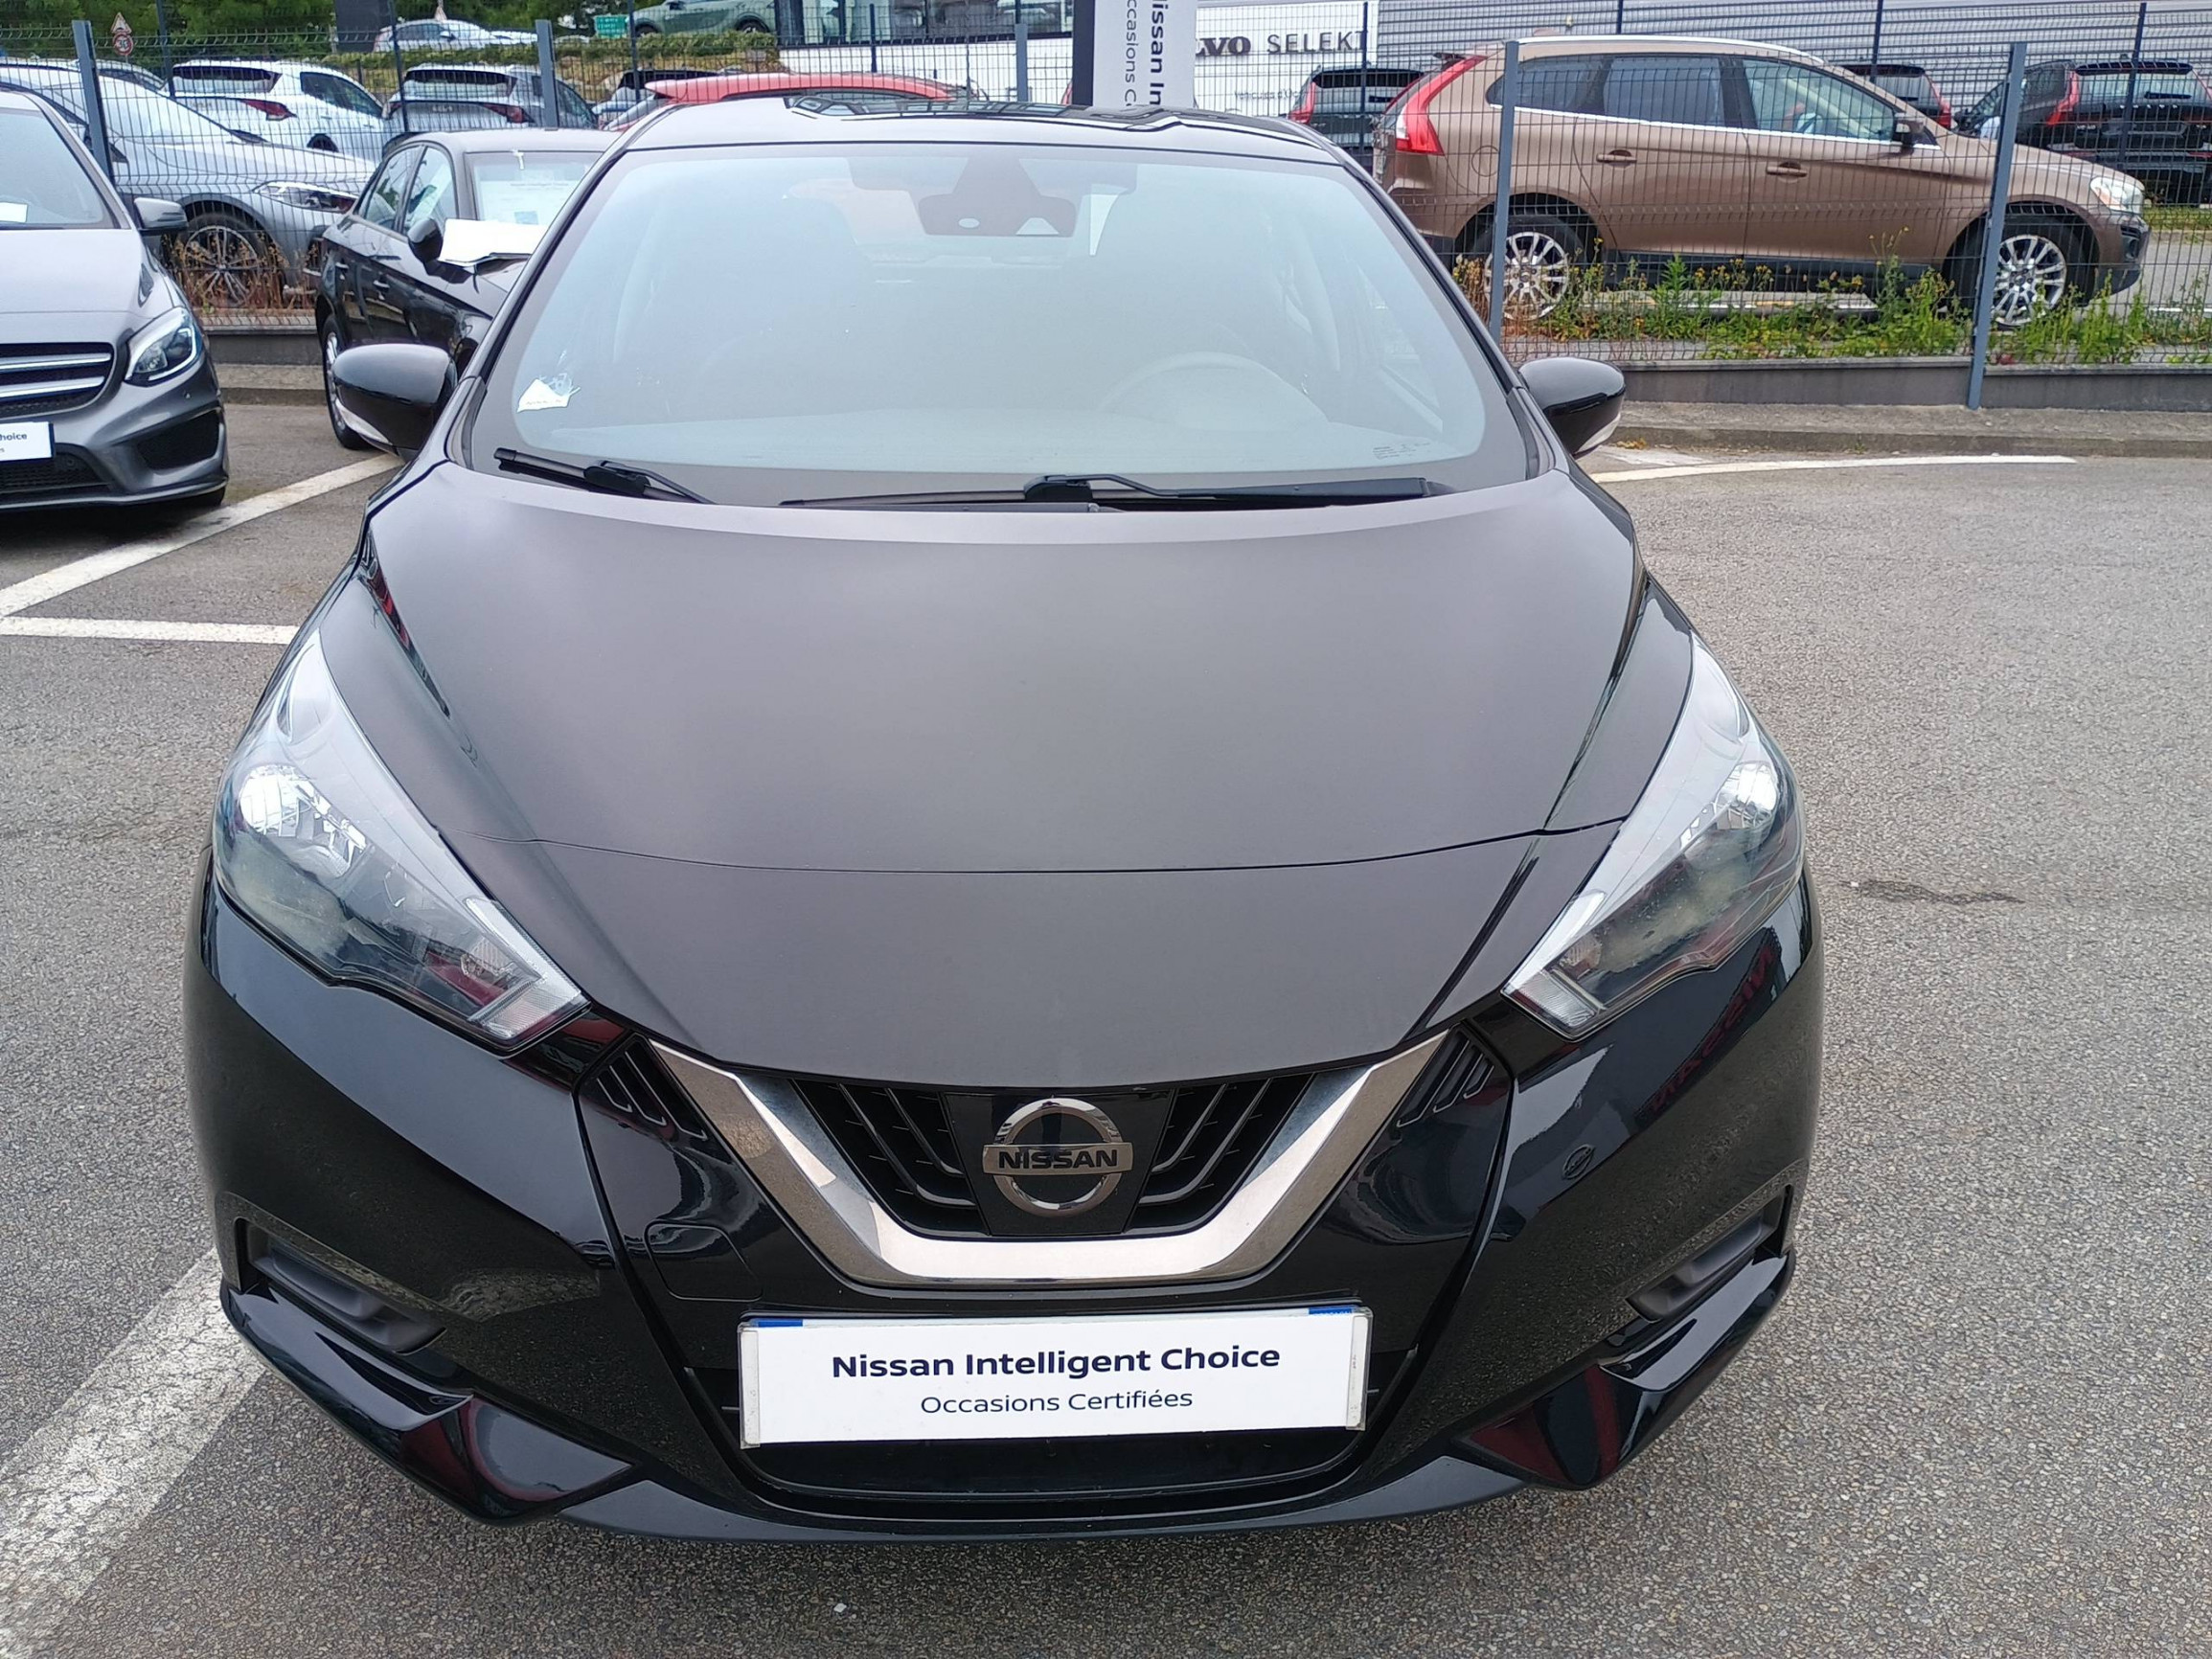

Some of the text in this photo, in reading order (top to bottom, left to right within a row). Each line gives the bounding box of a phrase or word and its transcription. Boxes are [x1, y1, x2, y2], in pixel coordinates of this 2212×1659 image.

[1151, 0, 1169, 73] issan
[1266, 31, 1368, 55] SELEKT
[1124, 0, 1139, 106] ccasions C
[0, 432, 28, 441] hoice
[998, 1149, 1118, 1170] NISSAN
[832, 1345, 1281, 1380] Nissan Intelligent Choice
[921, 1389, 1194, 1414] Occasions Certifiées
